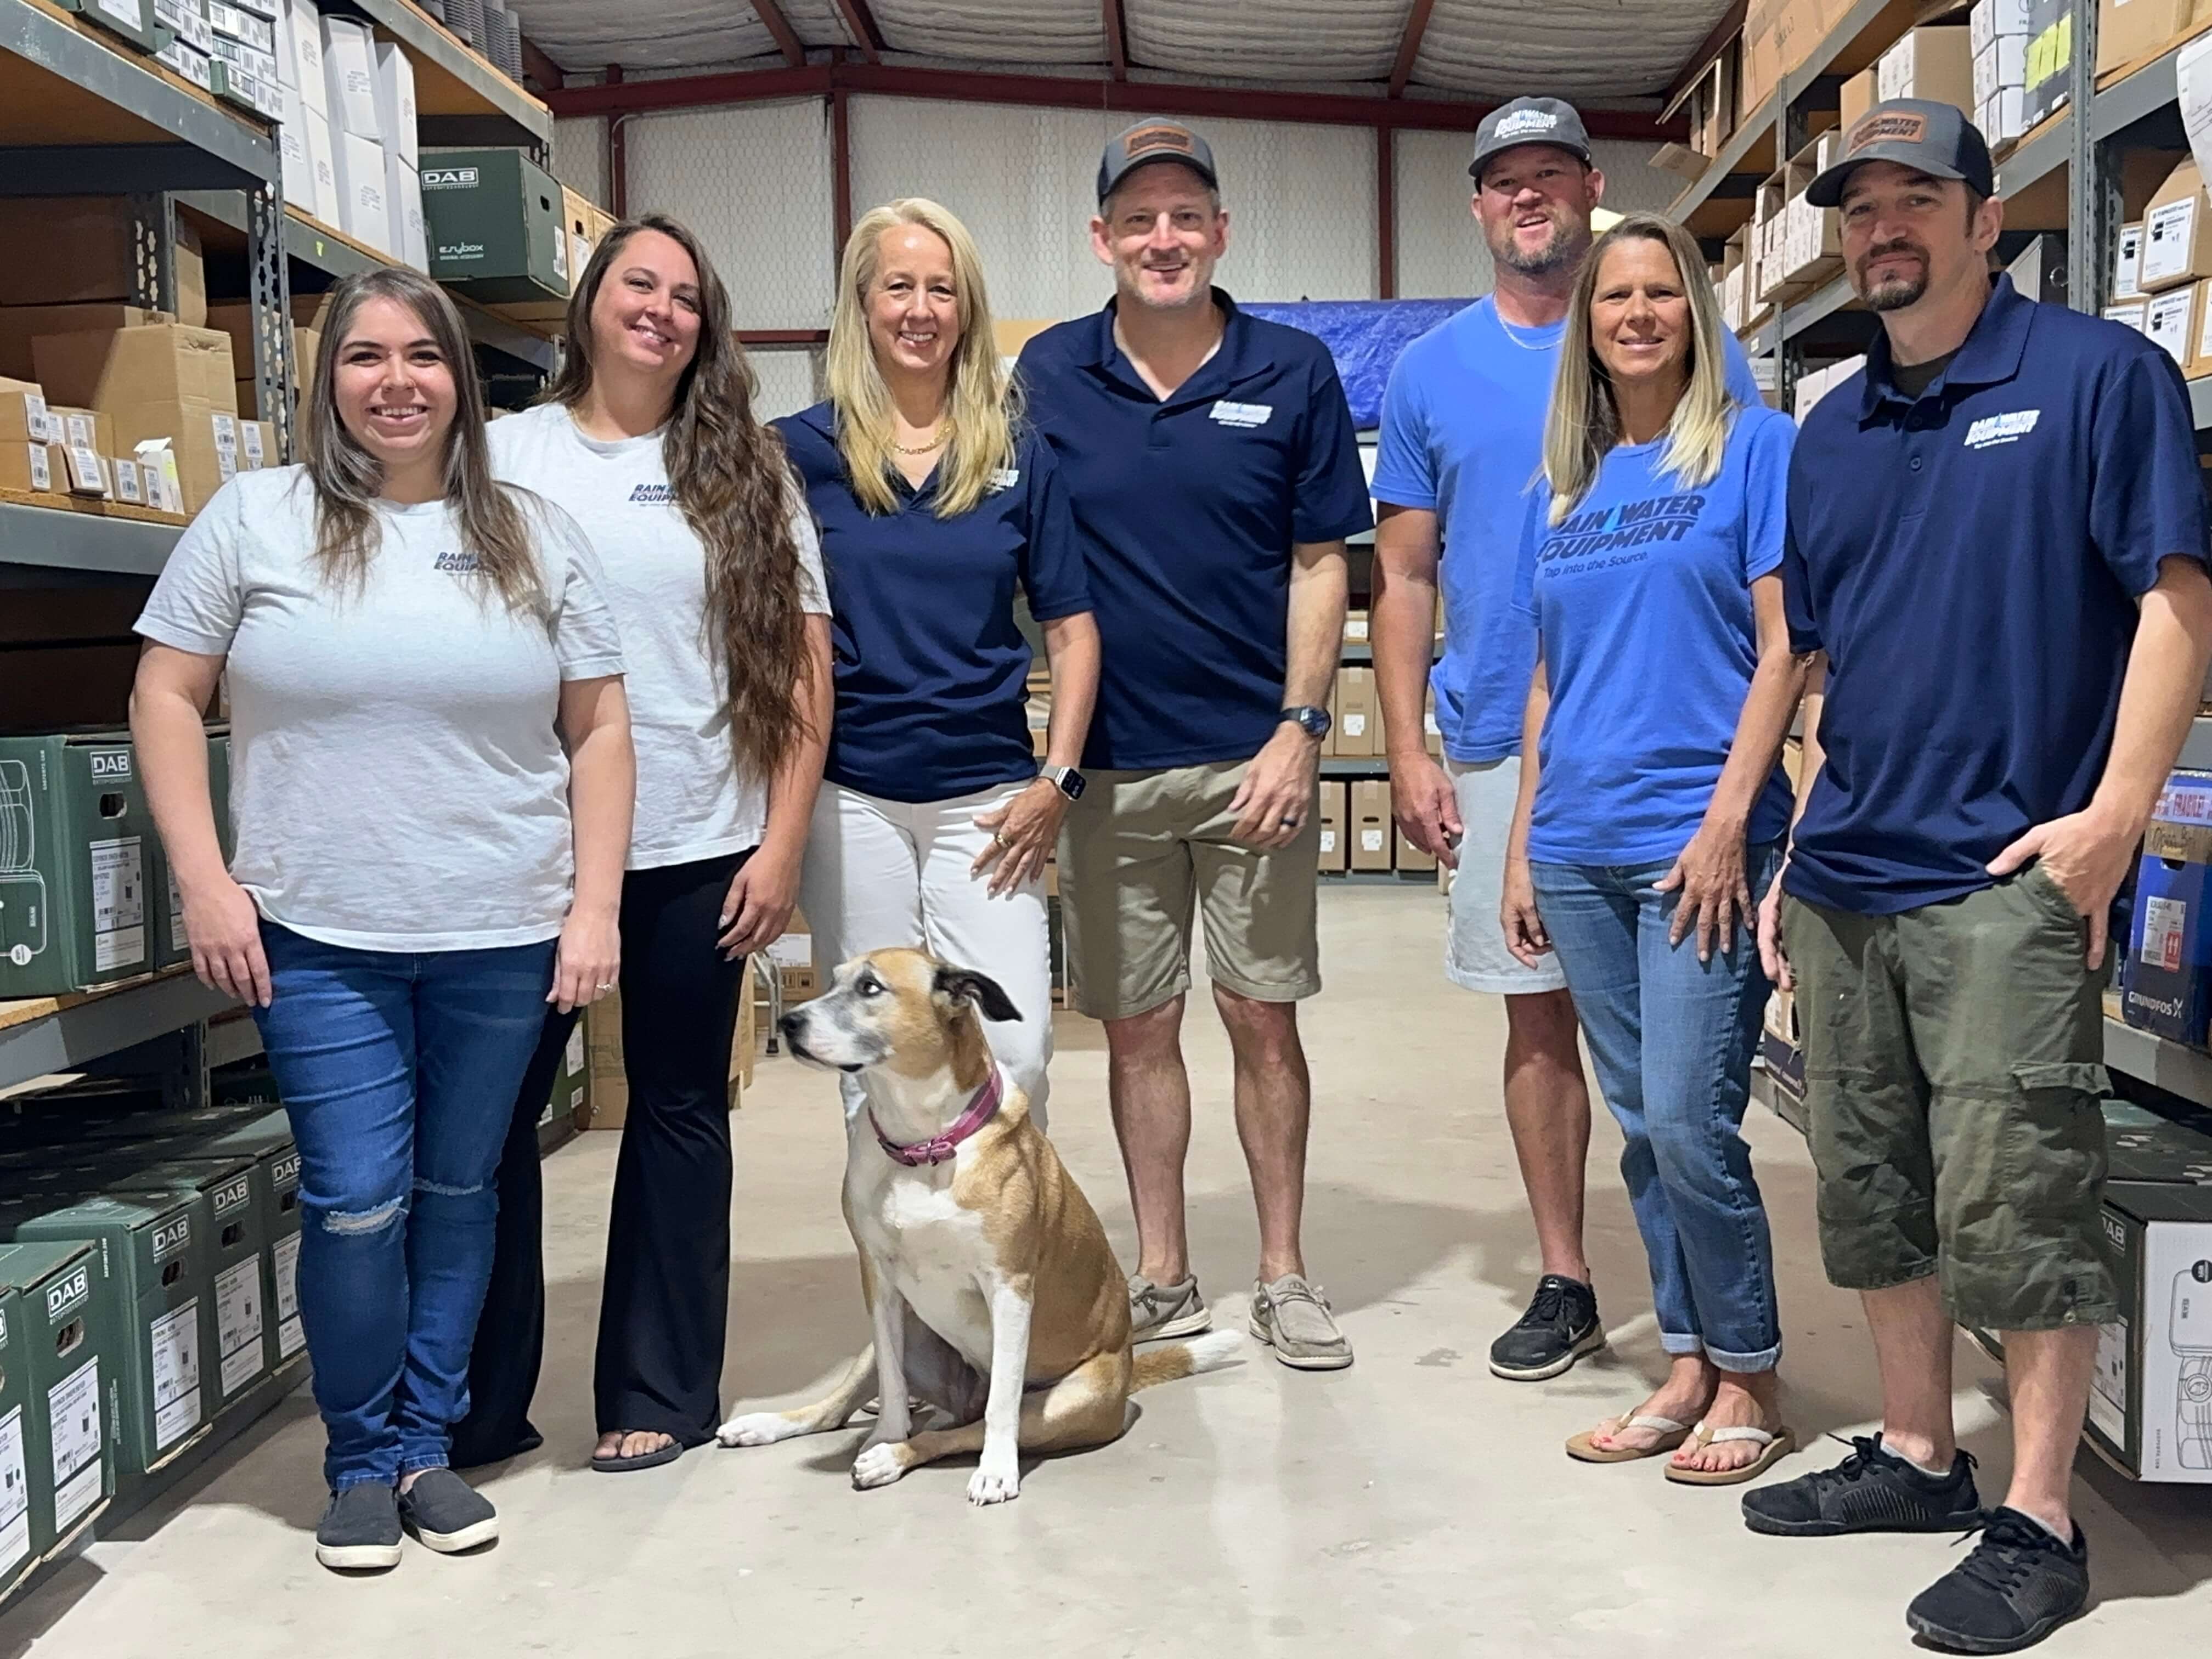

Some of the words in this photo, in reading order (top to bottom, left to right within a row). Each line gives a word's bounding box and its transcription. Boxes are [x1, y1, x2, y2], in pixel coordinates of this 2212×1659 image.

[424, 171, 475, 184] DAB
[634, 484, 666, 492] RAIN
[1556, 507, 1615, 535] AIN
[1617, 495, 1705, 525] WATER
[438, 551, 471, 562] RAIN
[1544, 567, 1561, 579] Tap
[1562, 563, 1584, 575] into
[1587, 558, 1606, 571] the
[93, 755, 129, 774] DAB
[215, 1181, 247, 1210] DAB
[155, 1220, 188, 1251] DAB
[49, 1273, 86, 1311] DAB
